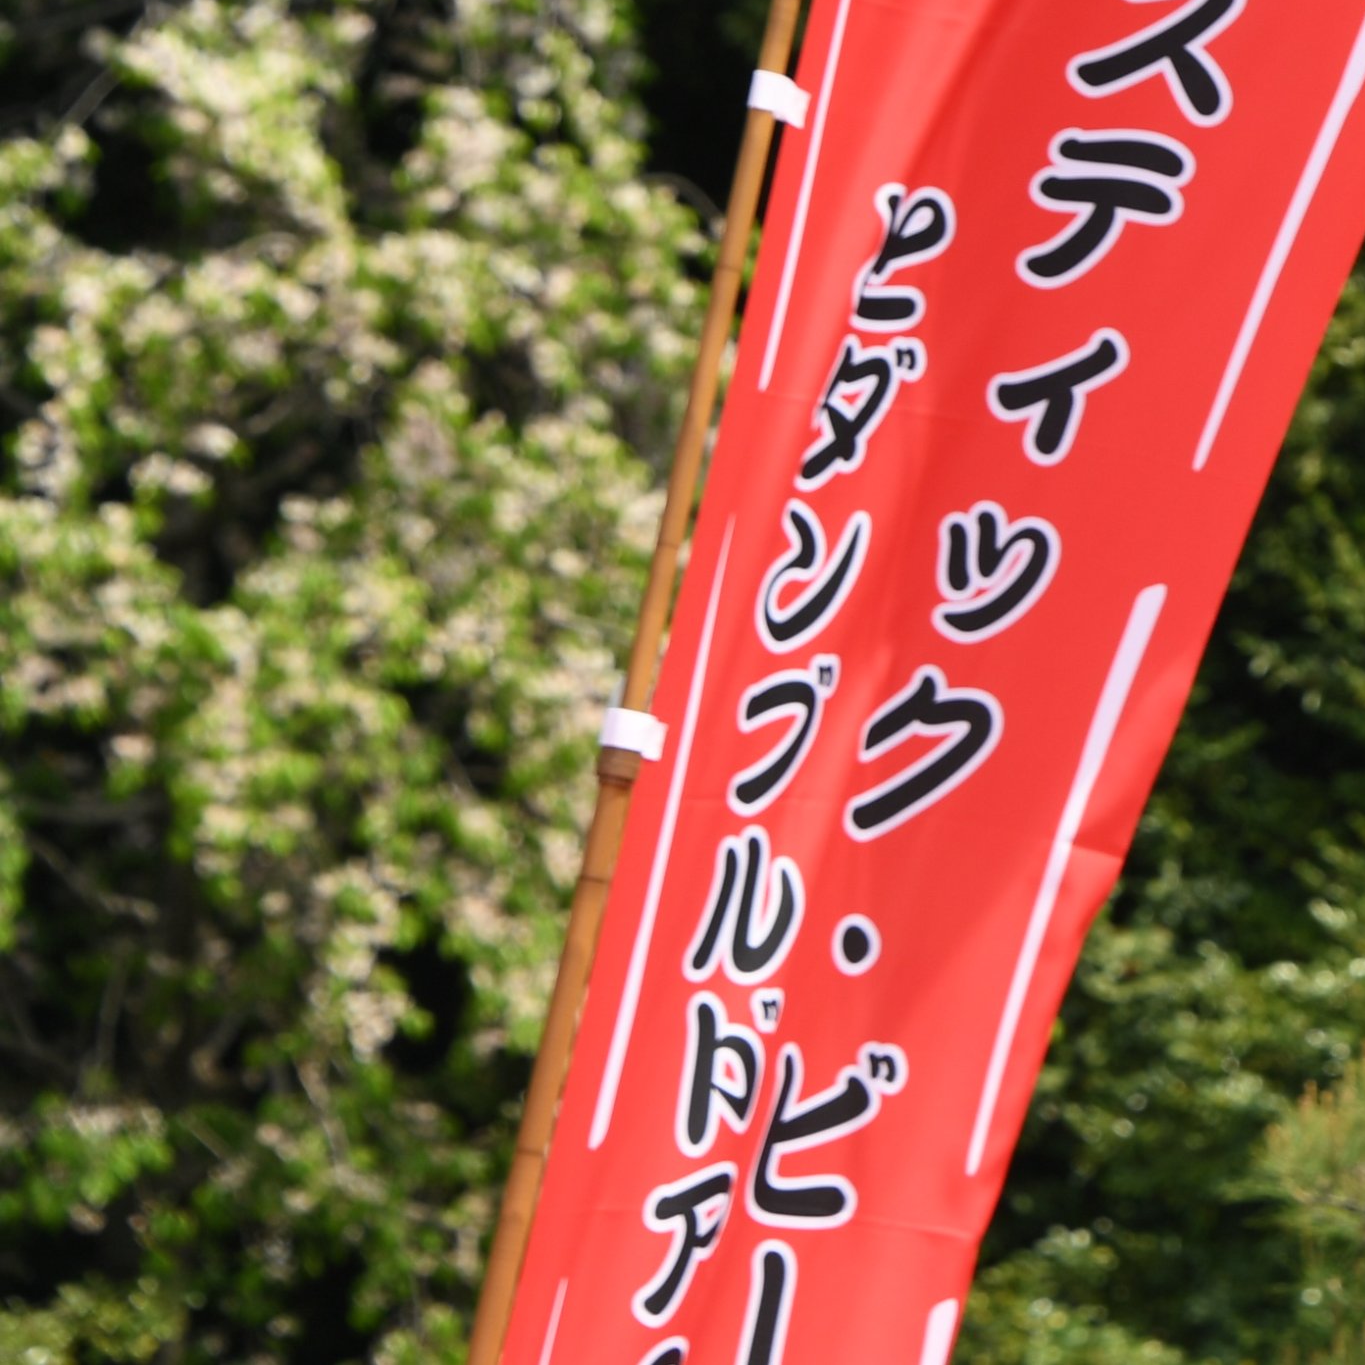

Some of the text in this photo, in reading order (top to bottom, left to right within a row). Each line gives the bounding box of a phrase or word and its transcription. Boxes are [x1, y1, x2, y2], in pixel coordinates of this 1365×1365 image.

[634, 184, 956, 1365] とダンブルドア
